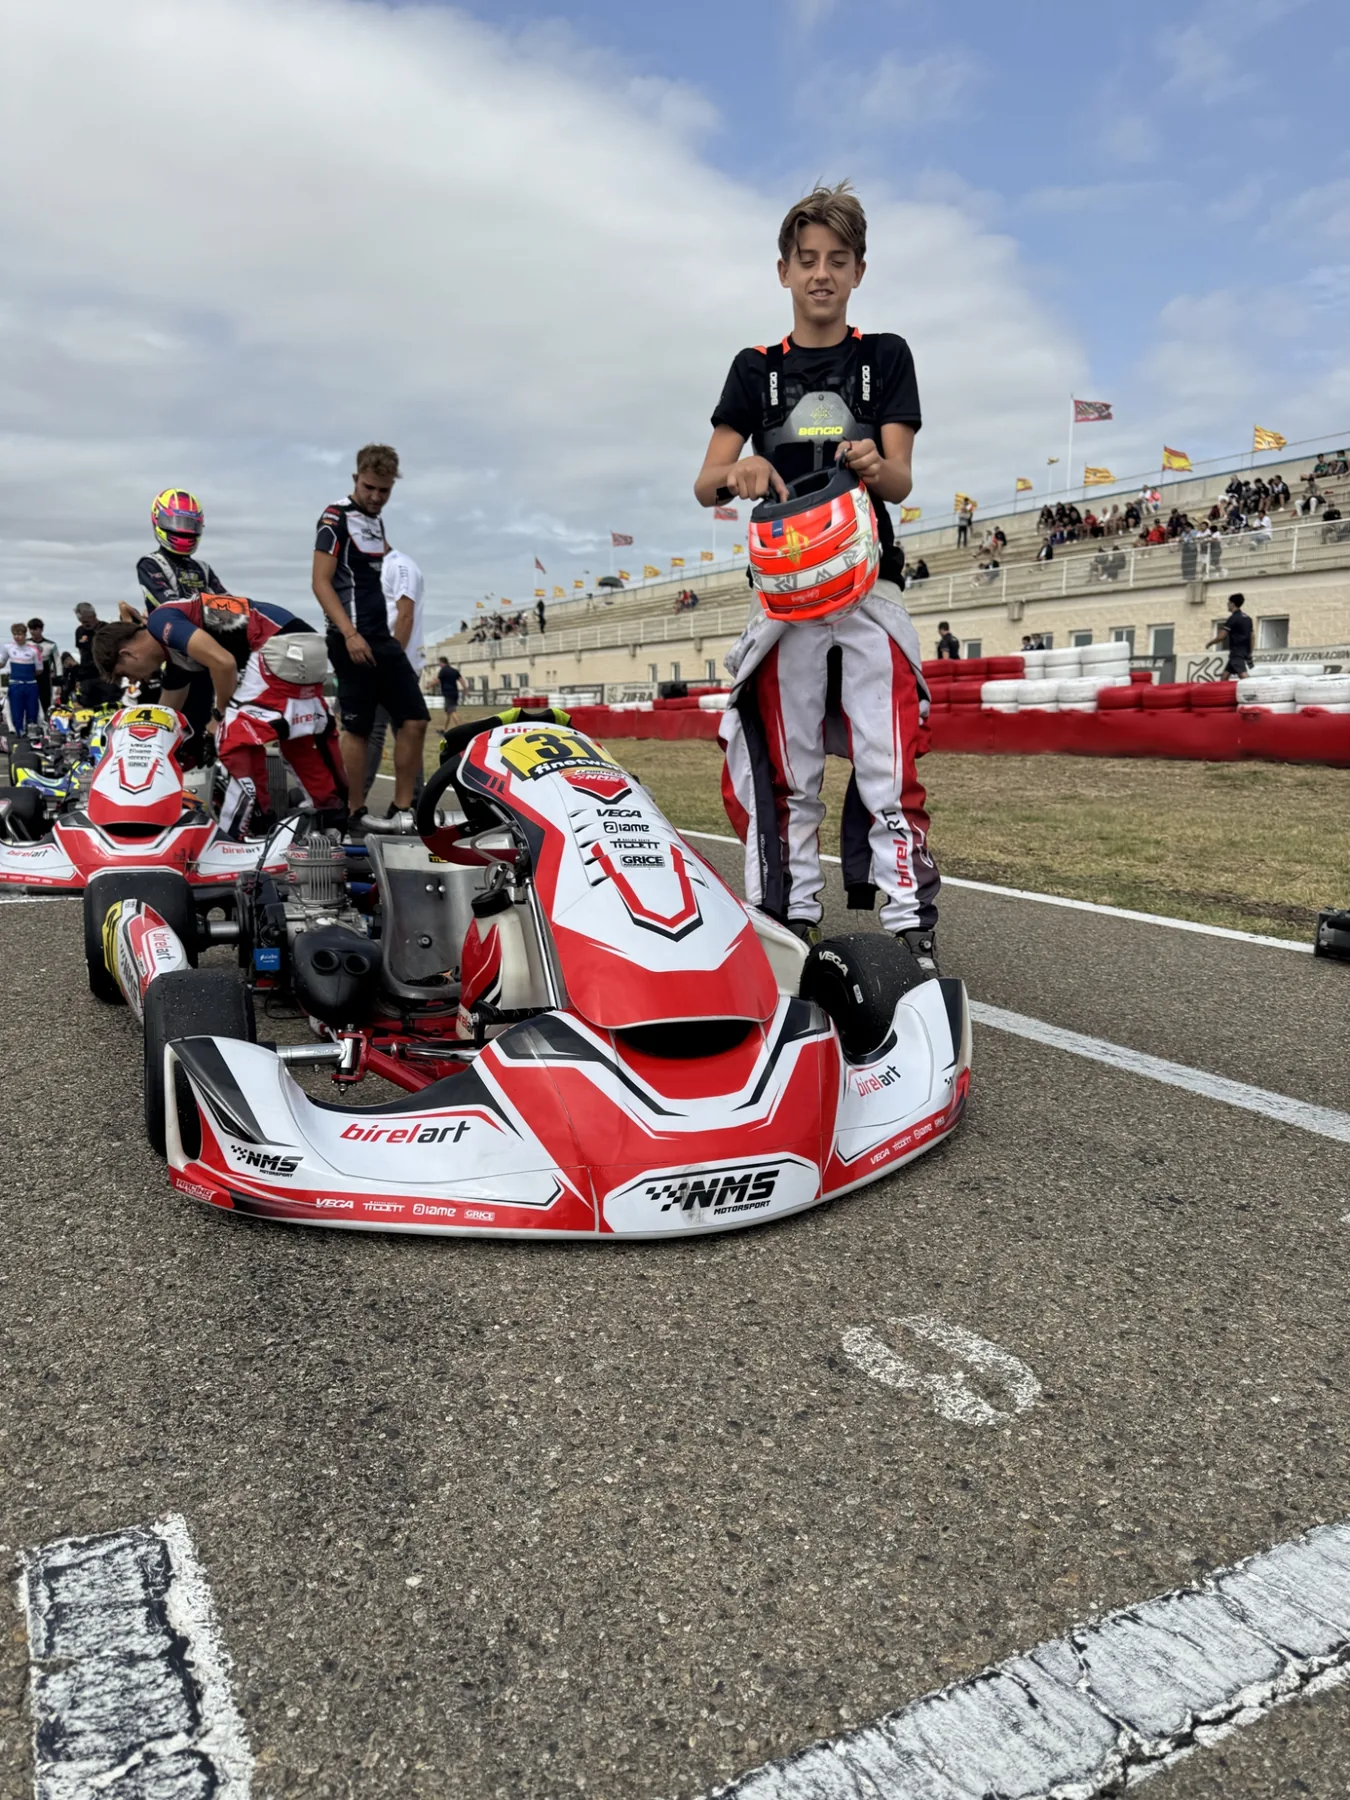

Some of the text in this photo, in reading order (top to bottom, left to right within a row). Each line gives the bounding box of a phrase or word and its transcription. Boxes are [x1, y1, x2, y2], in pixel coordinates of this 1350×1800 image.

[769, 371, 779, 406] BENGIO
[862, 365, 871, 401] BENGIO
[798, 426, 843, 436] BENGIO
[135, 709, 153, 721] 4
[525, 733, 605, 761] 31
[596, 809, 642, 818] VEGA
[621, 855, 664, 864] GRICE
[818, 950, 849, 978] VEGA
[854, 1064, 902, 1098] birelart
[340, 1120, 471, 1144] birelart
[245, 1151, 304, 1173] NMS
[869, 1148, 890, 1165] VEGA
[682, 1168, 779, 1211] NMS
[315, 1197, 354, 1209] VEGA
[713, 1199, 771, 1216] MOTORSPORT
